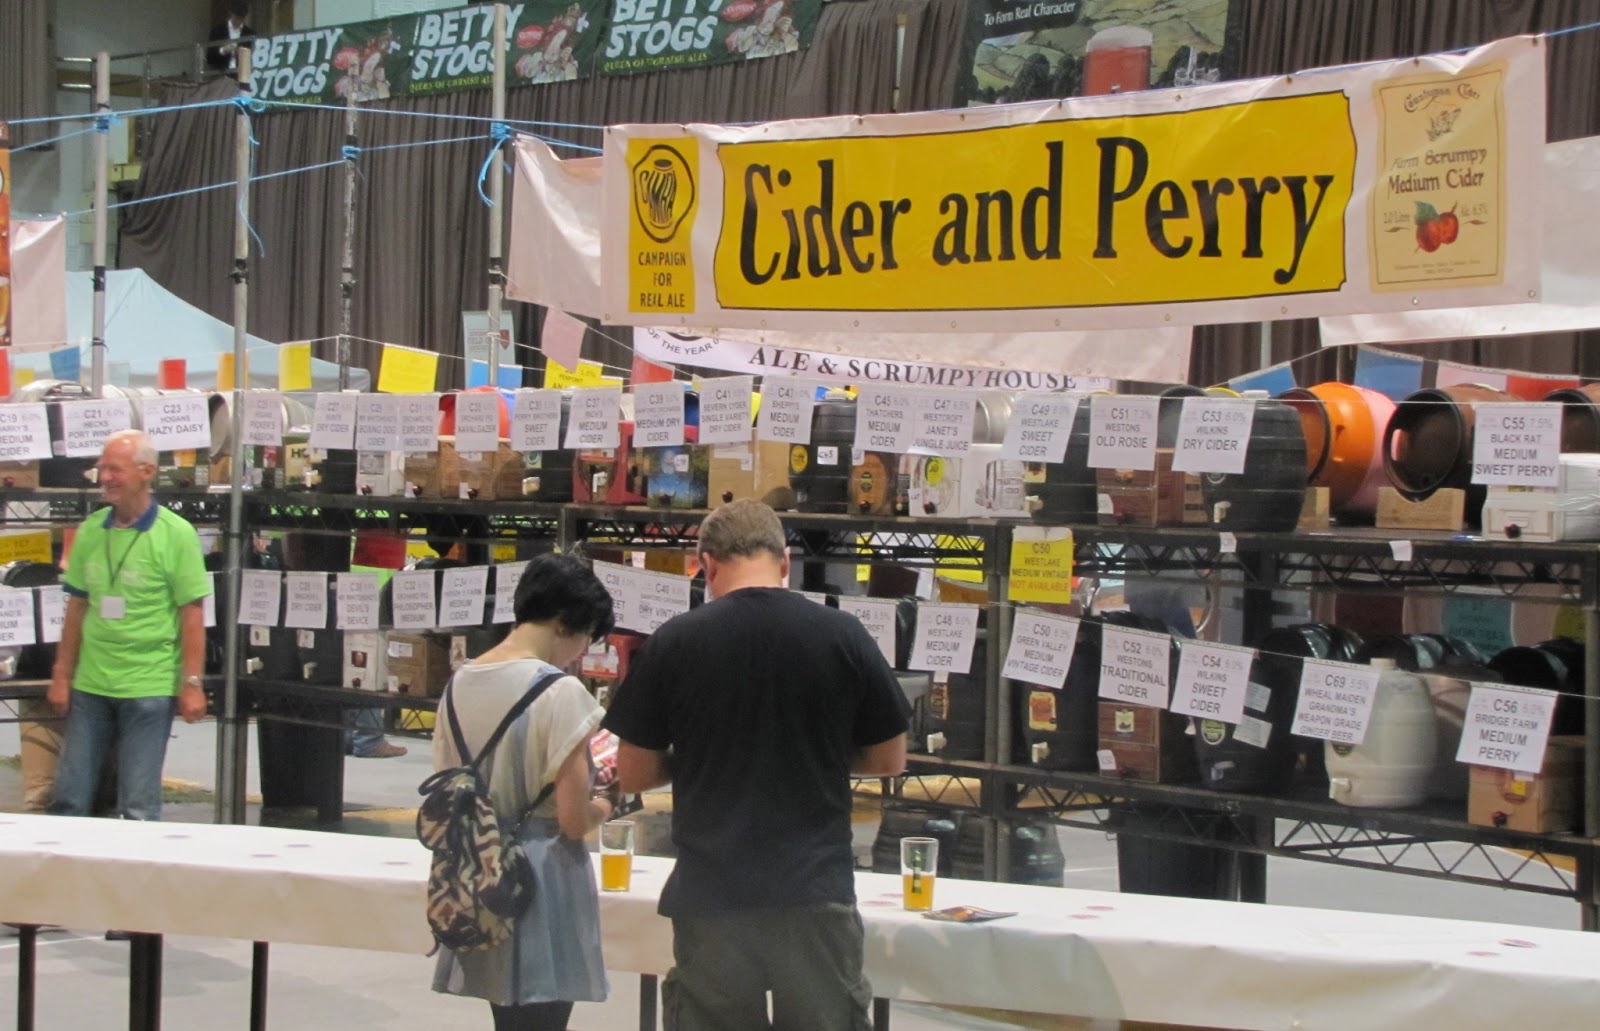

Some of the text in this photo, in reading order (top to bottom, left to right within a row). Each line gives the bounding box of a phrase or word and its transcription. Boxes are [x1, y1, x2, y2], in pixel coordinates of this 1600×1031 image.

[984, 2, 1076, 25] To Form Real Character
[418, 4, 524, 47] BETTY
[605, 15, 718, 58] STOGS
[252, 28, 344, 68] BETTY
[249, 63, 330, 99] STOGS
[1425, 148, 1487, 165] Scrumpy
[1387, 167, 1485, 200] Medium Cider
[739, 136, 1335, 285] Cider and Perry
[638, 252, 686, 266] CAMPAIGN
[653, 272, 672, 287] FOR
[667, 293, 685, 308] ALE
[661, 339, 681, 354] THE
[684, 342, 712, 355] YEAR
[748, 347, 1077, 390] ALE & SCRUMPY HOUSE
[874, 395, 891, 406] C45
[934, 399, 951, 410] C47
[84, 410, 101, 419] C21
[163, 404, 181, 414] C23
[866, 408, 903, 419] THATCHERS
[1031, 404, 1050, 417] C49
[1111, 408, 1129, 420] C51
[701, 413, 724, 422] SINGLE
[770, 412, 800, 422] MEDIUM
[923, 413, 963, 422] WESTCROFT
[1202, 411, 1222, 422] C53
[148, 423, 204, 435] HAZY DAISY
[524, 424, 548, 433] SWEET
[579, 421, 607, 430] MEDIUM
[636, 418, 680, 429] MEDIUM DRY
[709, 424, 742, 434] DRY CIDER
[868, 421, 901, 433] MEDIUM
[1021, 419, 1060, 428] WESTLAKE
[1105, 423, 1140, 432] WESTONS
[1502, 417, 1526, 430] C55
[68, 431, 90, 439] PORT
[647, 432, 669, 441] CIDER
[772, 427, 795, 437] CIDER
[925, 425, 958, 437] JANET'S
[1020, 431, 1054, 442] SWEET
[1196, 426, 1228, 435] WILKINS
[525, 437, 546, 446] CIDER
[579, 434, 603, 444] CIDER
[870, 436, 895, 447] CIDER
[1096, 435, 1148, 448] OLD ROSIE
[1490, 434, 1542, 443] BLACK RAT
[912, 439, 969, 451] JUNGLE JUICE
[1019, 445, 1047, 457] CIDER
[1183, 439, 1239, 451] DRY CIDER
[1494, 448, 1537, 460] MEDIUM
[1475, 464, 1555, 477] SWEET PERRY
[1032, 543, 1050, 554] C50
[1024, 558, 1061, 567] WESTLAKE
[1012, 568, 1040, 577] MEDIUM
[855, 609, 871, 620] C46
[936, 614, 952, 625] C48
[927, 629, 963, 638] WESTLAKE
[1033, 623, 1050, 637] C50
[926, 641, 960, 651] MEDIUM
[1017, 635, 1068, 651] GREEN VALLEY
[1123, 641, 1141, 654] C52
[926, 656, 953, 666] CIDER
[1024, 649, 1054, 662] MEDIUM
[1116, 654, 1152, 669] WESTONS
[1202, 655, 1221, 668] C54
[1007, 659, 1064, 678] VINTAGE CIDER
[1102, 665, 1166, 687] TRADITIONAL
[1197, 670, 1227, 682] WILKINS
[1325, 674, 1346, 688] C69
[1117, 684, 1148, 699] CIDER
[1191, 683, 1227, 698] SWEET
[1304, 688, 1367, 705] WHEAL MAIDEN
[1190, 699, 1221, 713] CIDER
[1309, 702, 1356, 716] GRANDMA'S
[1493, 699, 1518, 713] C56
[1298, 713, 1362, 730] WEAPON GRADE
[1475, 713, 1538, 730] BRIDGE FARM
[1331, 730, 1353, 741] BEER
[1480, 729, 1528, 746] MEDIUM
[1479, 747, 1520, 762] PERRY
